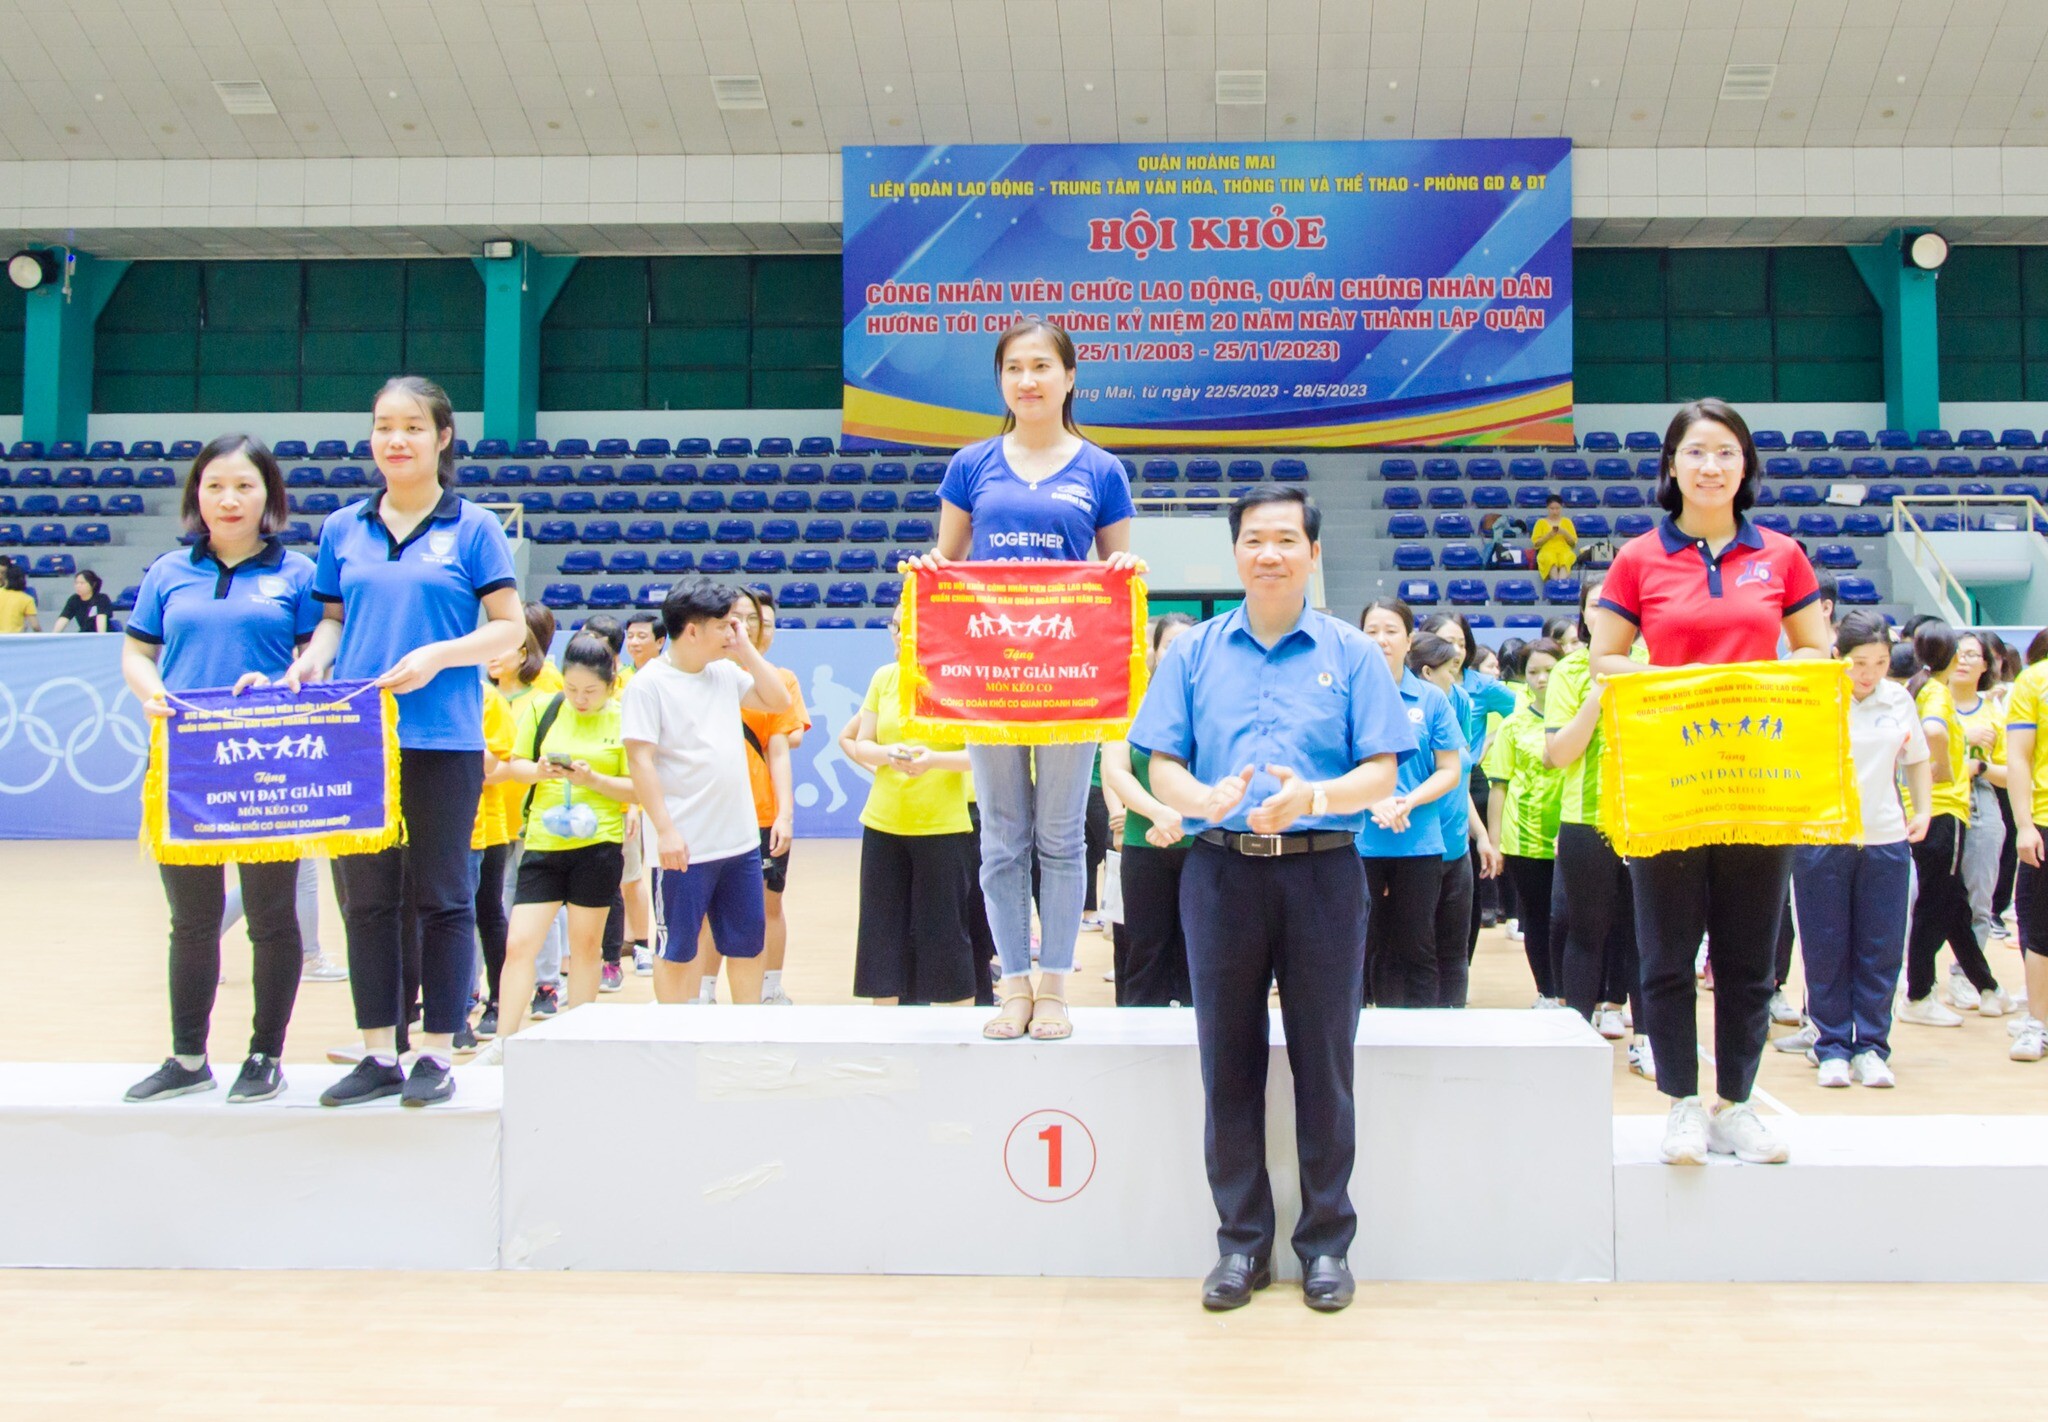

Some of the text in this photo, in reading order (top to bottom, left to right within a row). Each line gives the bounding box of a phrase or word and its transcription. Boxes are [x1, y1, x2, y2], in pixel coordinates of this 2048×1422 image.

[1138, 152, 1276, 174] QUẬN HOÀNG MAI
[870, 180, 905, 198] LIÊN
[910, 179, 952, 197] ĐOÀN
[957, 182, 986, 197] LAO
[990, 178, 1034, 199] ĐỘNG
[1050, 180, 1101, 196] TRUNG
[1106, 178, 1140, 195] TÂM
[1144, 177, 1179, 195] VĂN
[1182, 176, 1217, 196] HÓA,
[1222, 176, 1274, 194] THÔNG
[1280, 178, 1305, 193] TIN
[1309, 174, 1330, 193] VÀ
[1335, 172, 1364, 192] THẾ
[1368, 177, 1408, 192] THAO
[1424, 173, 1479, 191] PHÒNG
[1483, 176, 1505, 190] GD
[1509, 175, 1522, 190] &
[1526, 174, 1547, 190] ĐT
[1089, 204, 1326, 261] HỘI KHỎE
[866, 273, 1552, 305] CÔNG NHÂN VIÊN CHỨC LAO ĐỘNG, QUẦN CHÚNG NHÂN DÂN
[866, 311, 939, 334] HƯỚNG
[945, 311, 977, 333] TỚI
[984, 310, 1040, 332] CHÀ
[1117, 307, 1147, 331] KỶ
[1151, 309, 1204, 335] NIỆM
[1210, 312, 1236, 331] 20
[1243, 308, 1294, 331] NĂM
[1300, 308, 1357, 331] NGÀY
[1363, 307, 1432, 330] THÀNH
[1439, 306, 1479, 333] LẬP
[1485, 306, 1545, 333] QUẬN
[1213, 341, 1340, 362] 25/11/2023)
[1105, 385, 1136, 399] Mai,
[1142, 384, 1159, 398] từ
[1162, 384, 1201, 400] ngày
[1205, 385, 1279, 398] 22/5/2023
[1293, 384, 1368, 398] 28/5/2023
[989, 532, 1065, 549] TOGETHER
[1067, 582, 1081, 591] LAO
[940, 661, 1099, 681] ĐƠN VỊ ĐẠT GIẢI NHẤT
[985, 681, 1053, 693] MÔN KÉO CO
[940, 697, 964, 707] CÔNG
[1020, 699, 1042, 709] QUAN
[1043, 699, 1071, 708] DOANH
[206, 781, 353, 805] ĐƠN VỊ ĐẠT GIẢI NHÌ
[238, 805, 263, 818] MÔN
[291, 803, 308, 815] CO
[1039, 1125, 1062, 1187] 1
